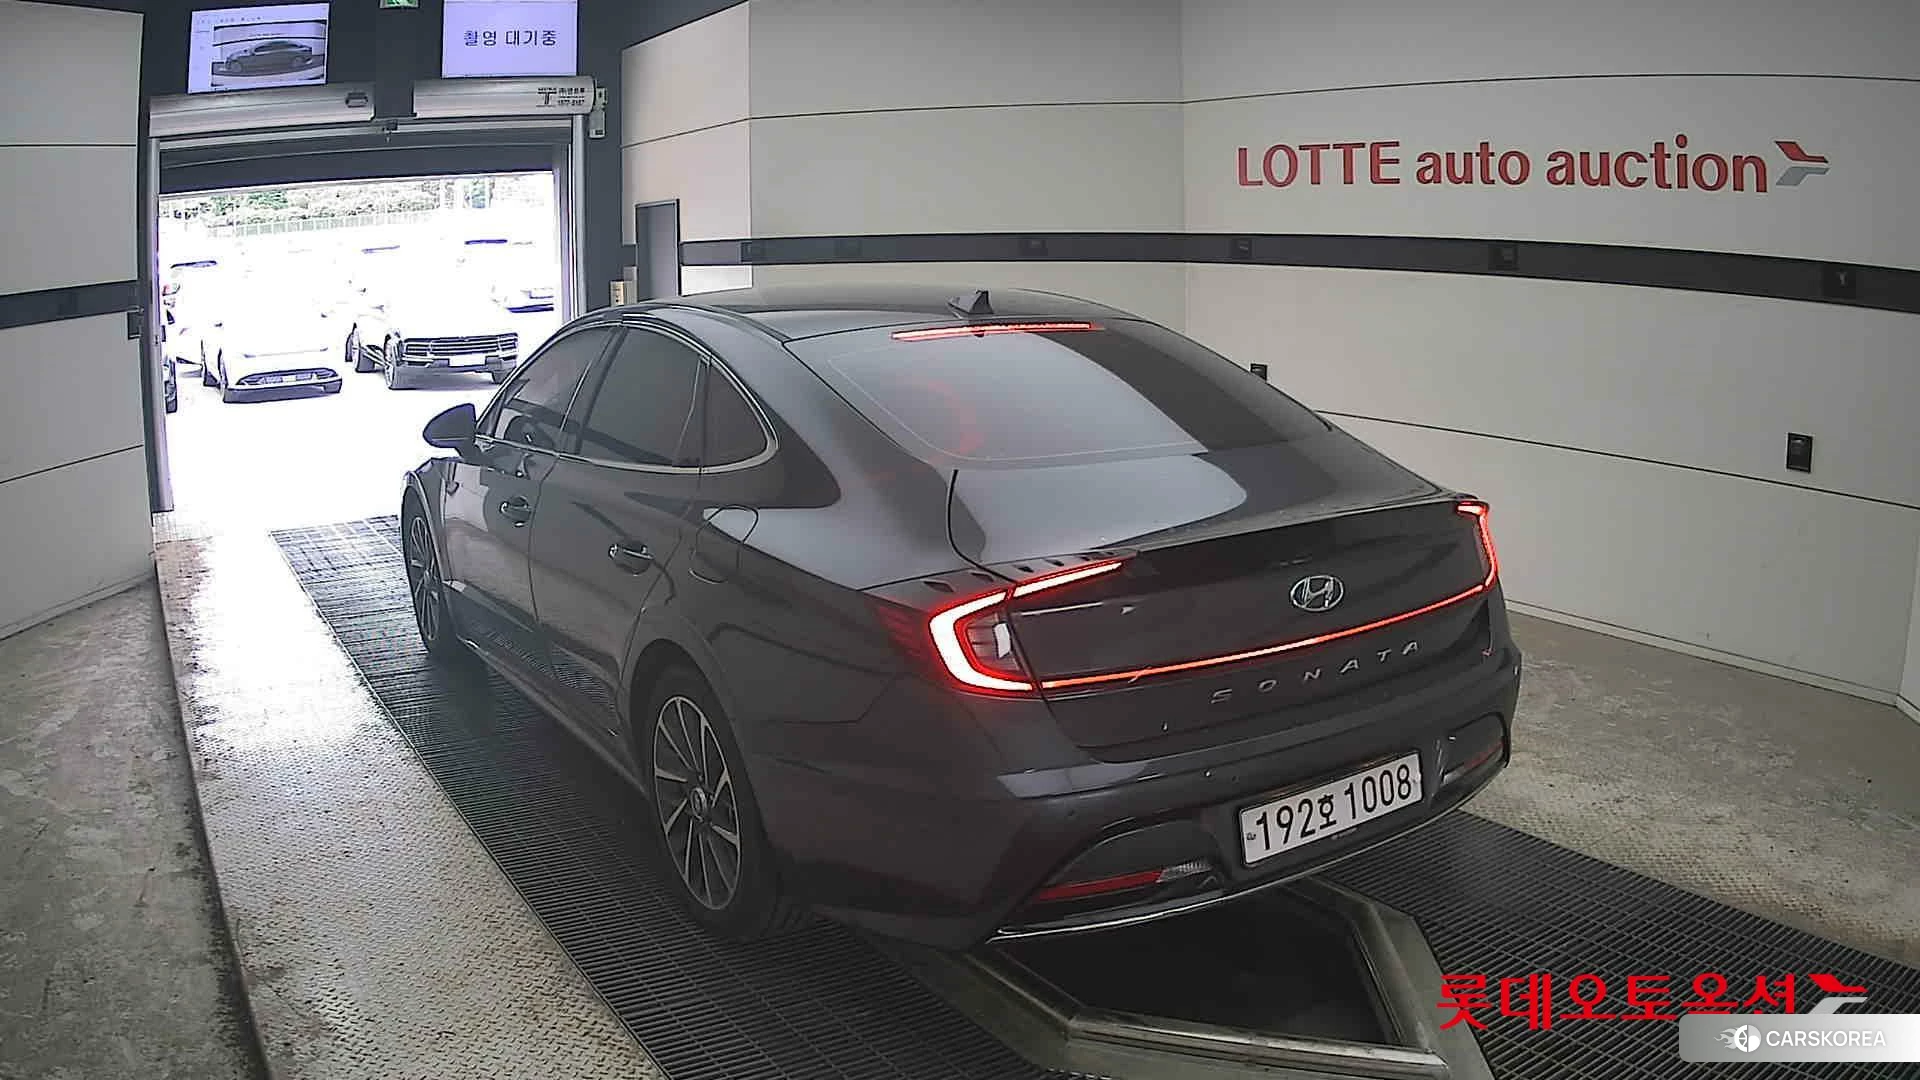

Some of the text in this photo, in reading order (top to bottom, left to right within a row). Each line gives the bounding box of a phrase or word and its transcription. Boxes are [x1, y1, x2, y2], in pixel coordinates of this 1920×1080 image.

[505, 29, 556, 46] 대기중
[1237, 135, 1769, 194] LOTTE auto auction
[1209, 641, 1419, 704] SONATA
